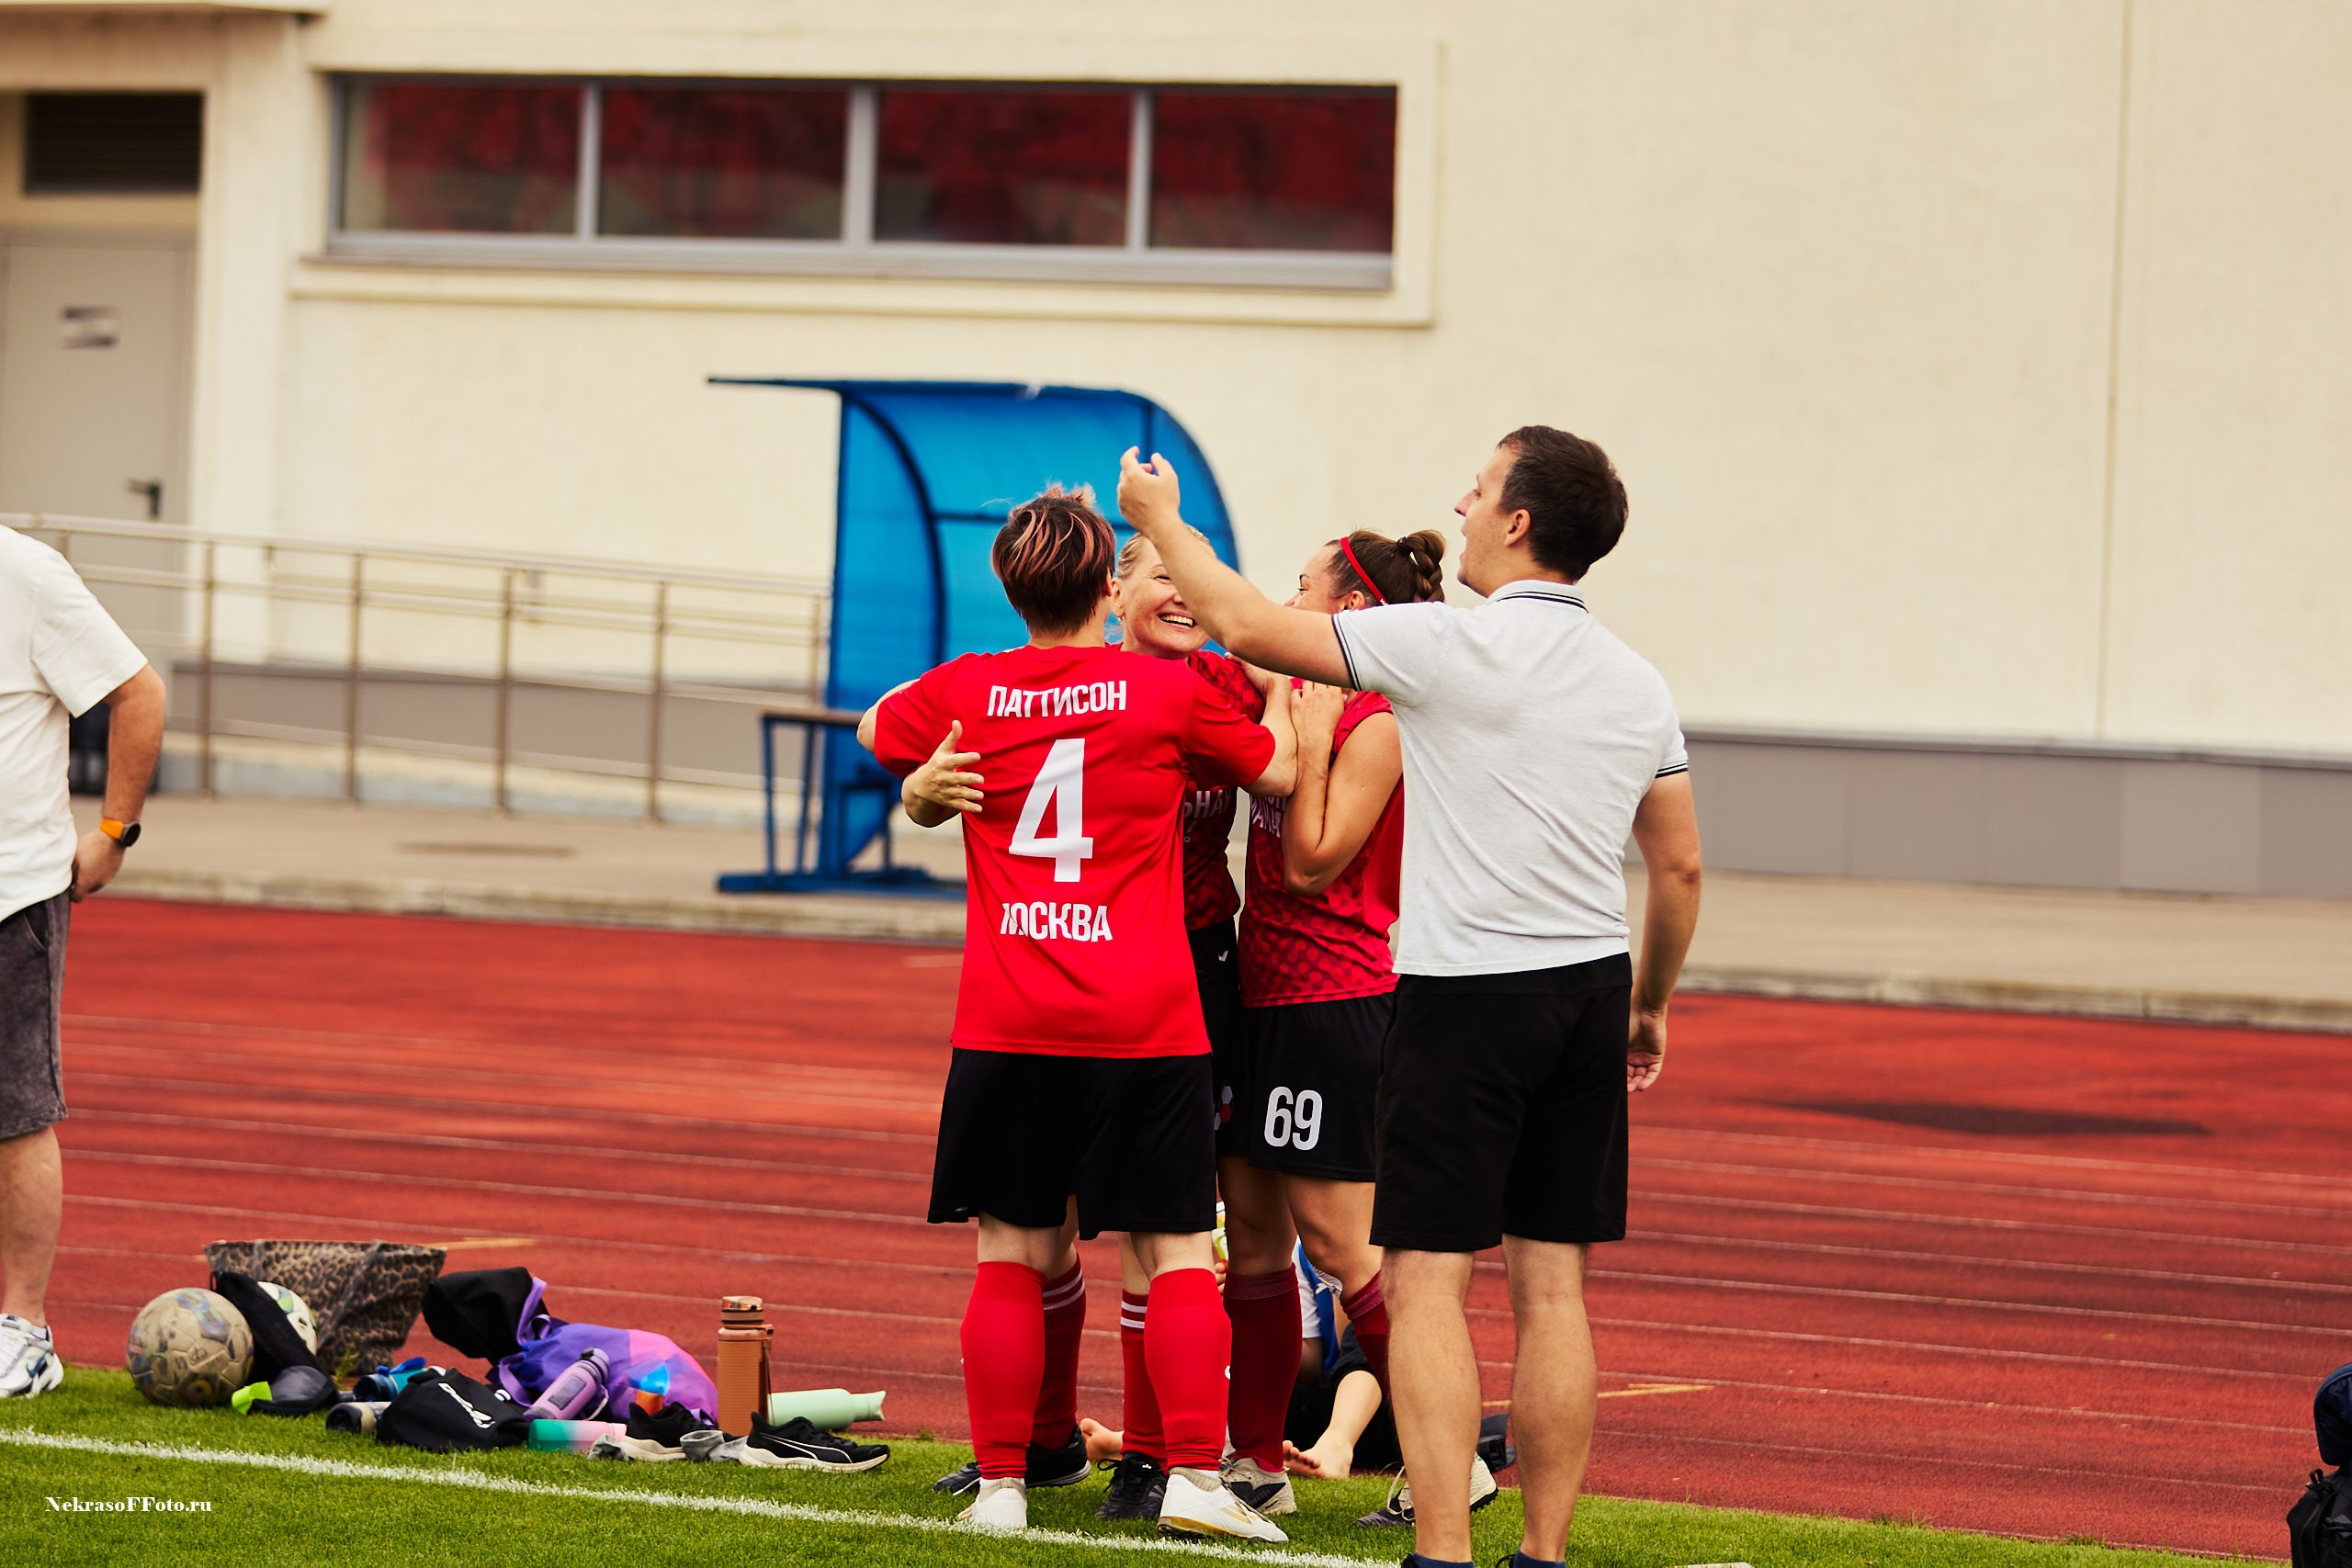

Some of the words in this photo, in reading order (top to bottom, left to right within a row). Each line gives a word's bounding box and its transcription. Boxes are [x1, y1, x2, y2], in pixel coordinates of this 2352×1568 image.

[987, 680, 1127, 717] ПАТТИСОН
[1009, 739, 1093, 883] 4
[1264, 1086, 1323, 1151] 69
